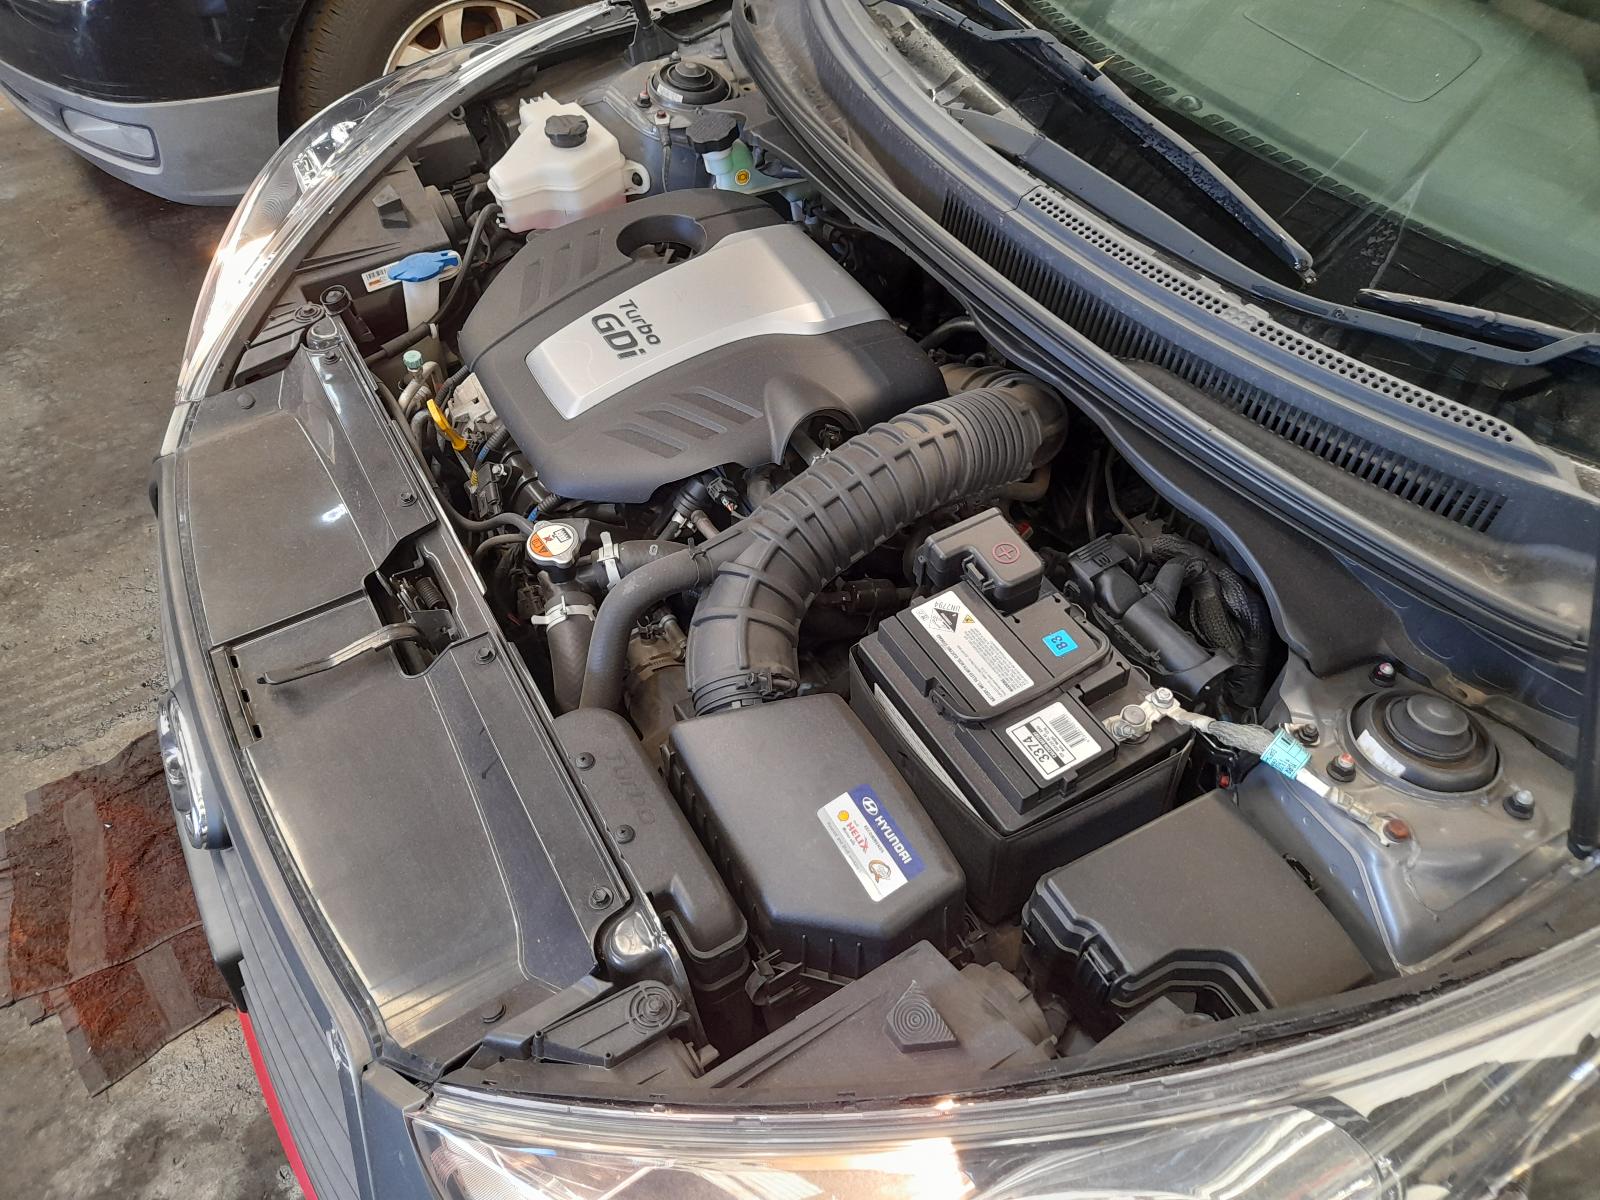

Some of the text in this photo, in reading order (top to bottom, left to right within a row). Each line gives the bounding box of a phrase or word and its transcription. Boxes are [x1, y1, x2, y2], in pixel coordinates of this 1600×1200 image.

[592, 313, 646, 359] GDi
[619, 299, 661, 345] Turbo
[1051, 635, 1068, 651] B3
[1023, 736, 1050, 763] 3374
[846, 821, 869, 854] HELIX
[874, 815, 912, 864] HYUNDAI
